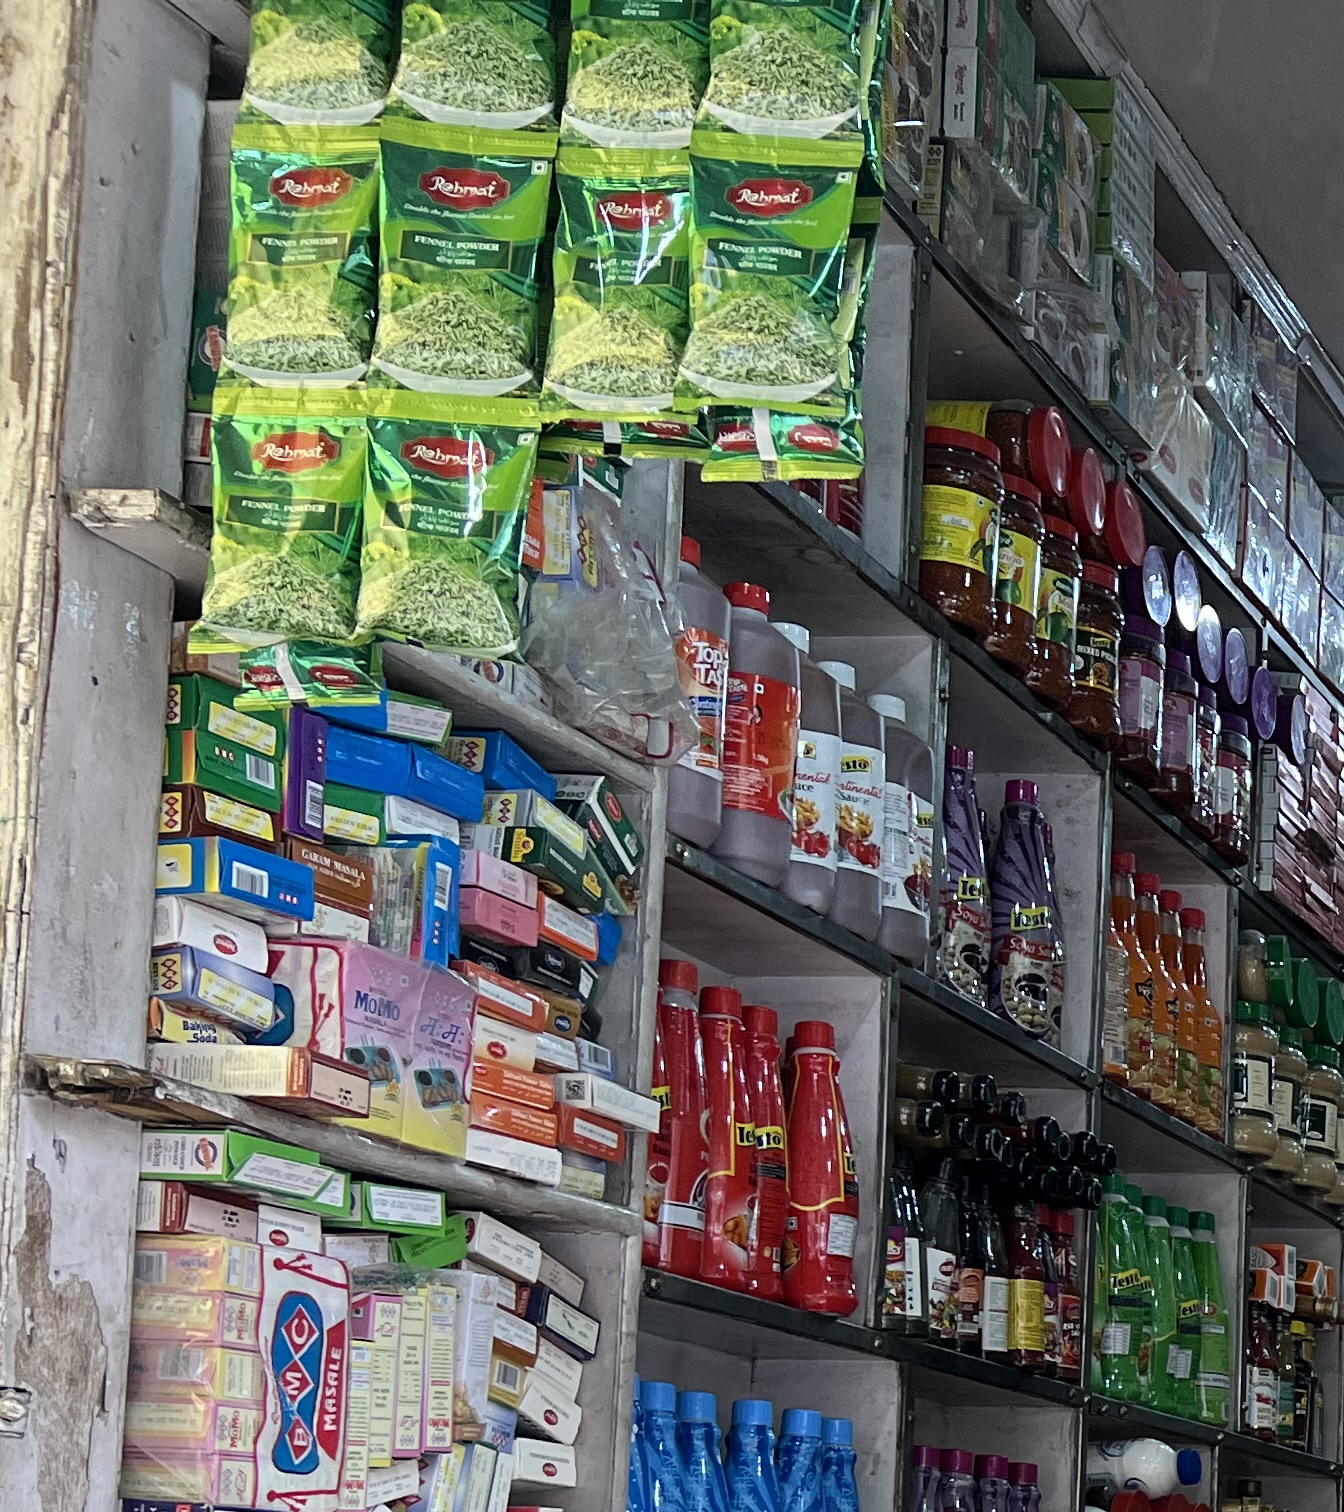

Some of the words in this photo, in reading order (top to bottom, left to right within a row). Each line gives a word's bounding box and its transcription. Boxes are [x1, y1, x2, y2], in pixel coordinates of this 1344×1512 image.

[278, 176, 341, 199] Rehmat
[429, 176, 498, 199] Rehmat
[736, 188, 800, 205] Rehmat
[414, 235, 453, 247] FENNEL
[456, 241, 499, 251] POWDER
[718, 242, 755, 253] FENNEL
[759, 245, 802, 259] POWDER
[262, 442, 327, 463] Rehmat
[242, 500, 279, 510] FENNEL
[694, 641, 723, 664] Top
[301, 849, 331, 868] GARAM
[334, 861, 365, 880] MASALA
[354, 990, 400, 1021] MoMo
[183, 1020, 217, 1033] Baking
[193, 1031, 217, 1044] Soda
[323, 1347, 343, 1432] MASALE
